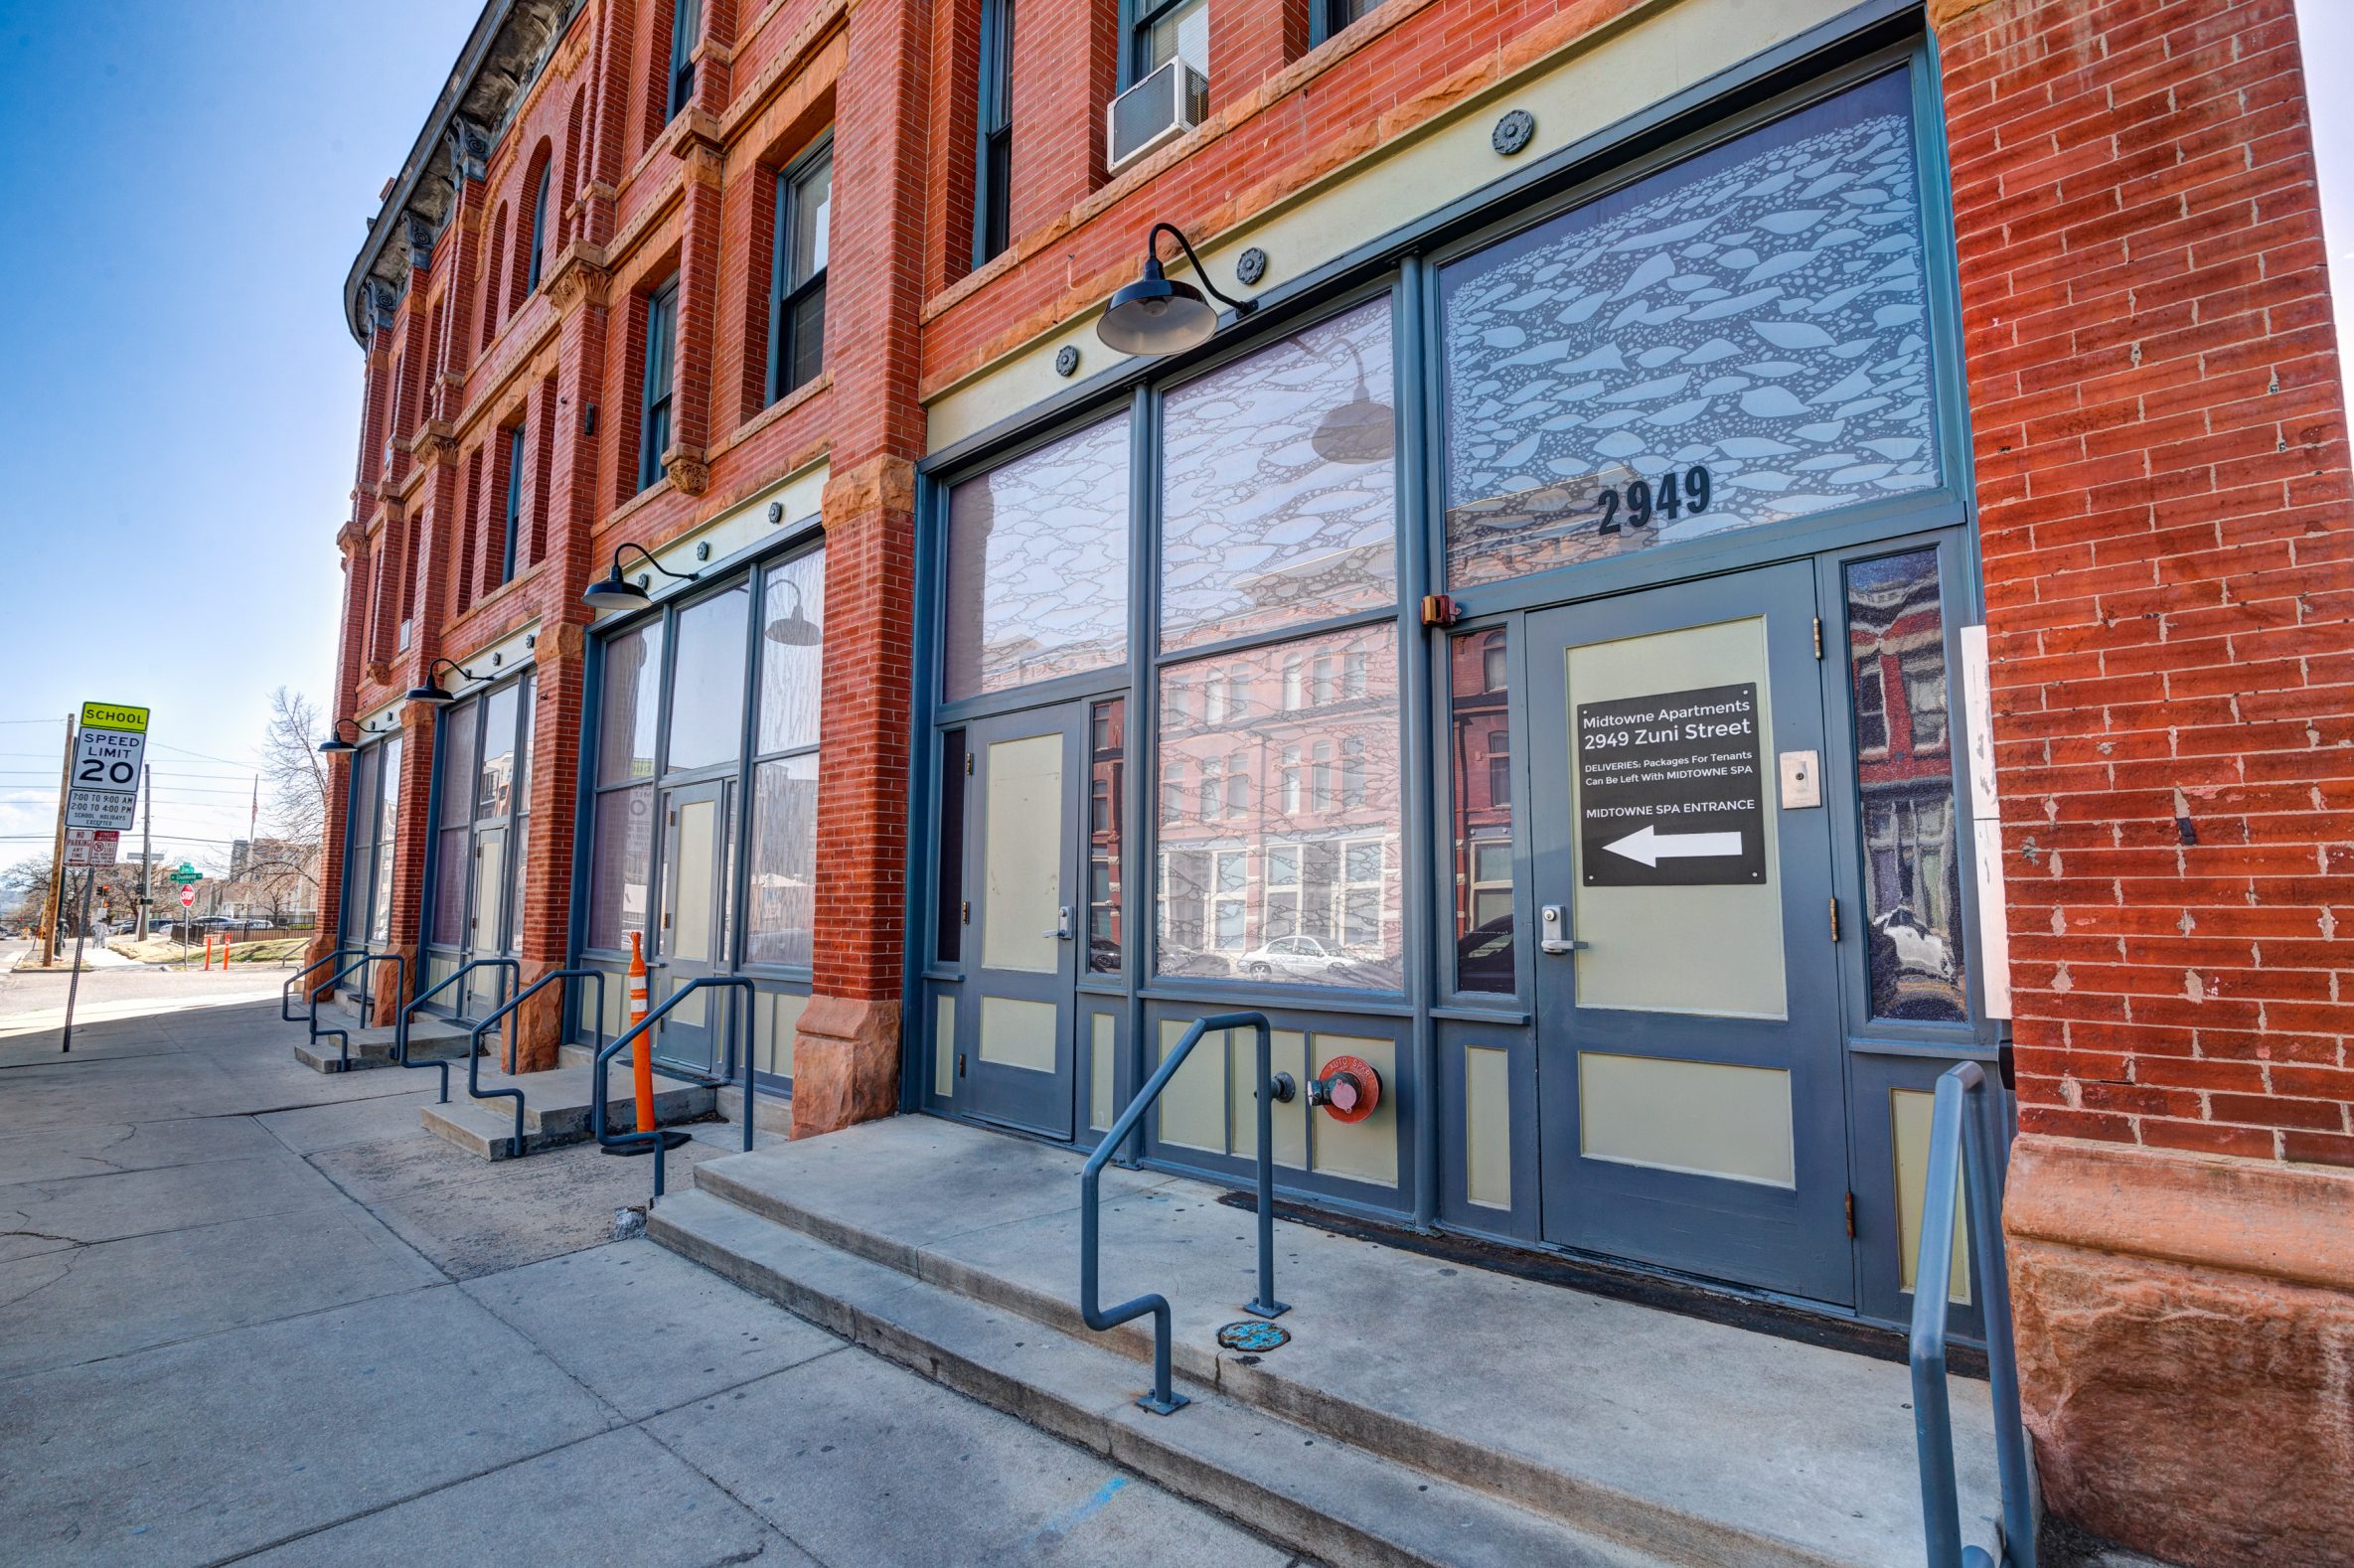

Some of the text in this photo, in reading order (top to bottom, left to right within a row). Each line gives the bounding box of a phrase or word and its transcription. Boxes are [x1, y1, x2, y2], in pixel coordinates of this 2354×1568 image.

[1598, 466, 1710, 536] 2949
[85, 708, 145, 724] SCHOOL
[1583, 700, 1750, 729] Midtowne Apartments
[83, 733, 140, 747] SPEED
[1584, 718, 1752, 750] 2949 Zuni Street
[87, 746, 132, 759] LIMIT
[1585, 751, 1752, 773] DELIVERIES: Packages For Tenants
[79, 758, 134, 784] 20
[1586, 777, 1603, 786] Can
[1620, 774, 1640, 783] Left
[1641, 772, 1664, 782] With
[1666, 767, 1728, 779] MIDTOWNE
[1730, 765, 1753, 775] SPA
[73, 792, 89, 802] 7:00
[103, 795, 119, 804] 9:00
[71, 802, 87, 811] 2:00
[90, 803, 99, 812] TO
[1586, 800, 1755, 819] MIDTOWNE SPA ENTRANCE
[181, 891, 193, 900] STOP
[1330, 1057, 1347, 1070] AUTO
